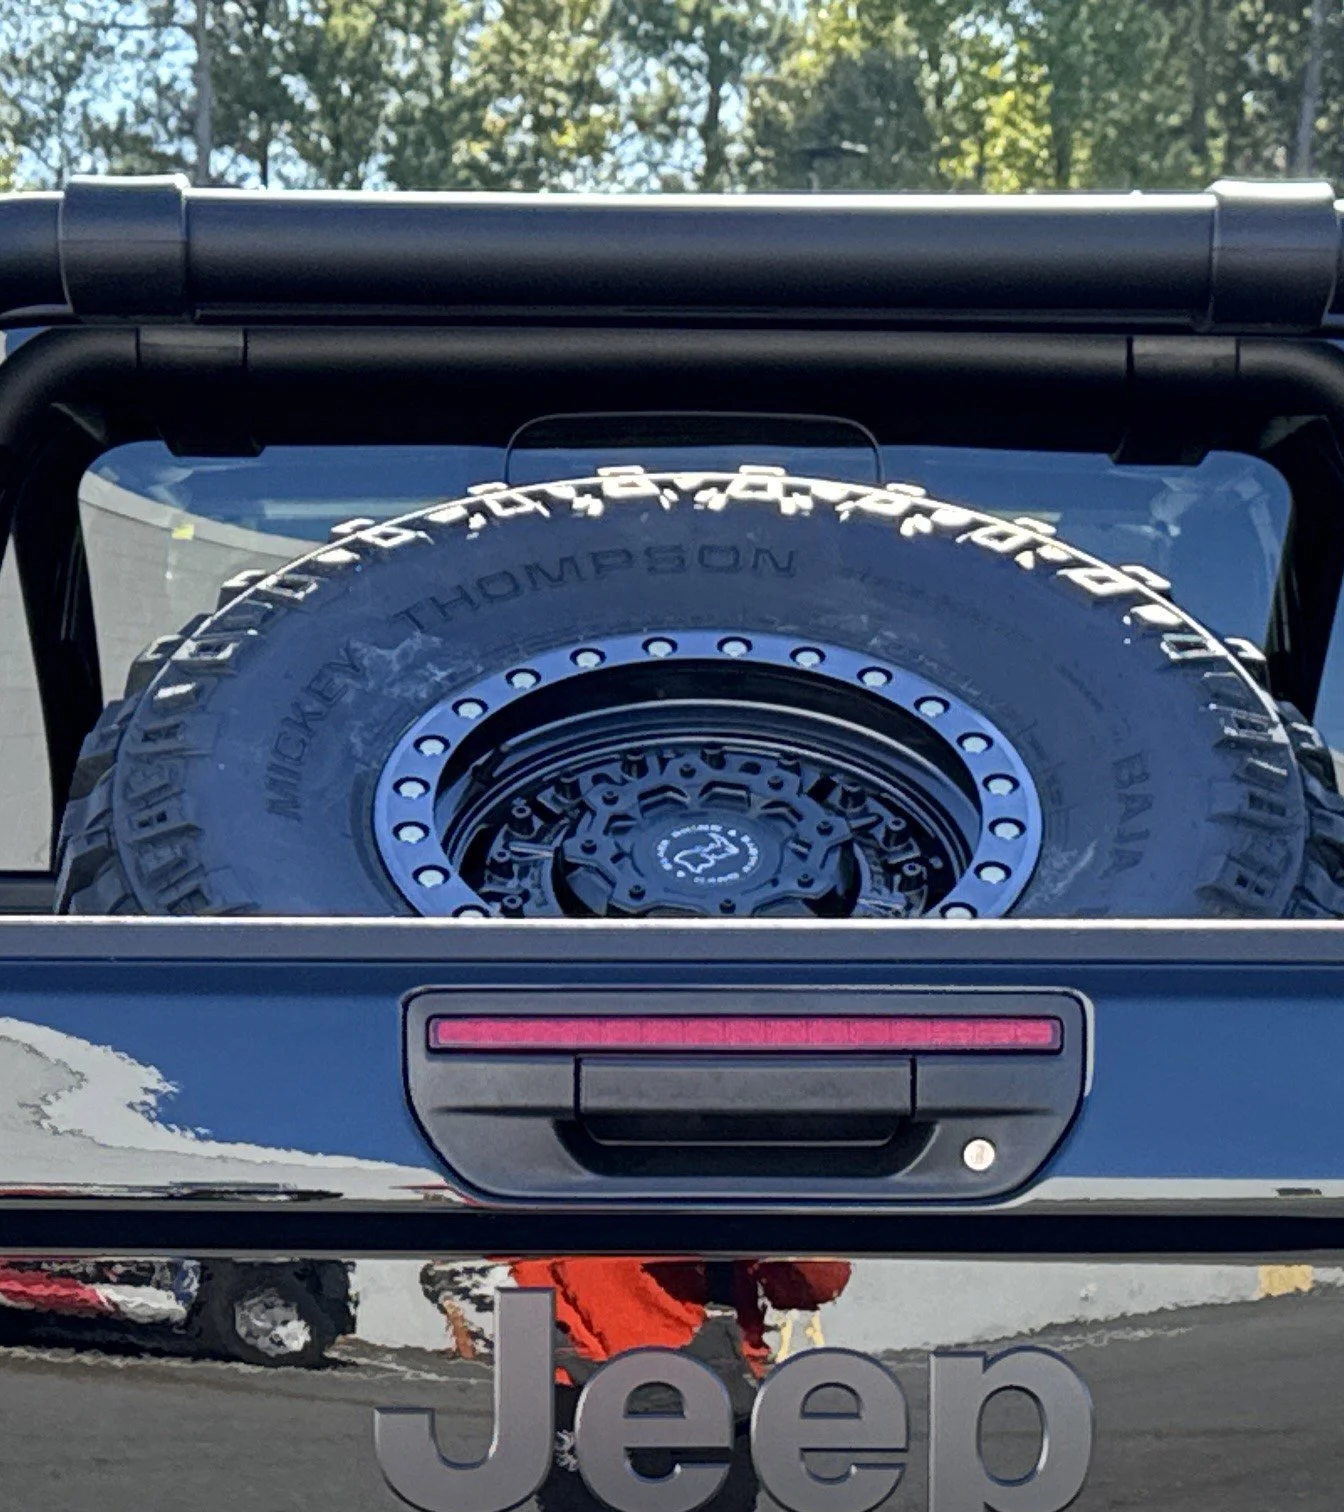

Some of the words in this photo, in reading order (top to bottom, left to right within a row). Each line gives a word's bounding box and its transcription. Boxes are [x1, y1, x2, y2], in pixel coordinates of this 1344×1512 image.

[266, 640, 363, 822] MICKEY
[392, 544, 798, 634] THOMPSON
[1102, 752, 1152, 880] BAJA
